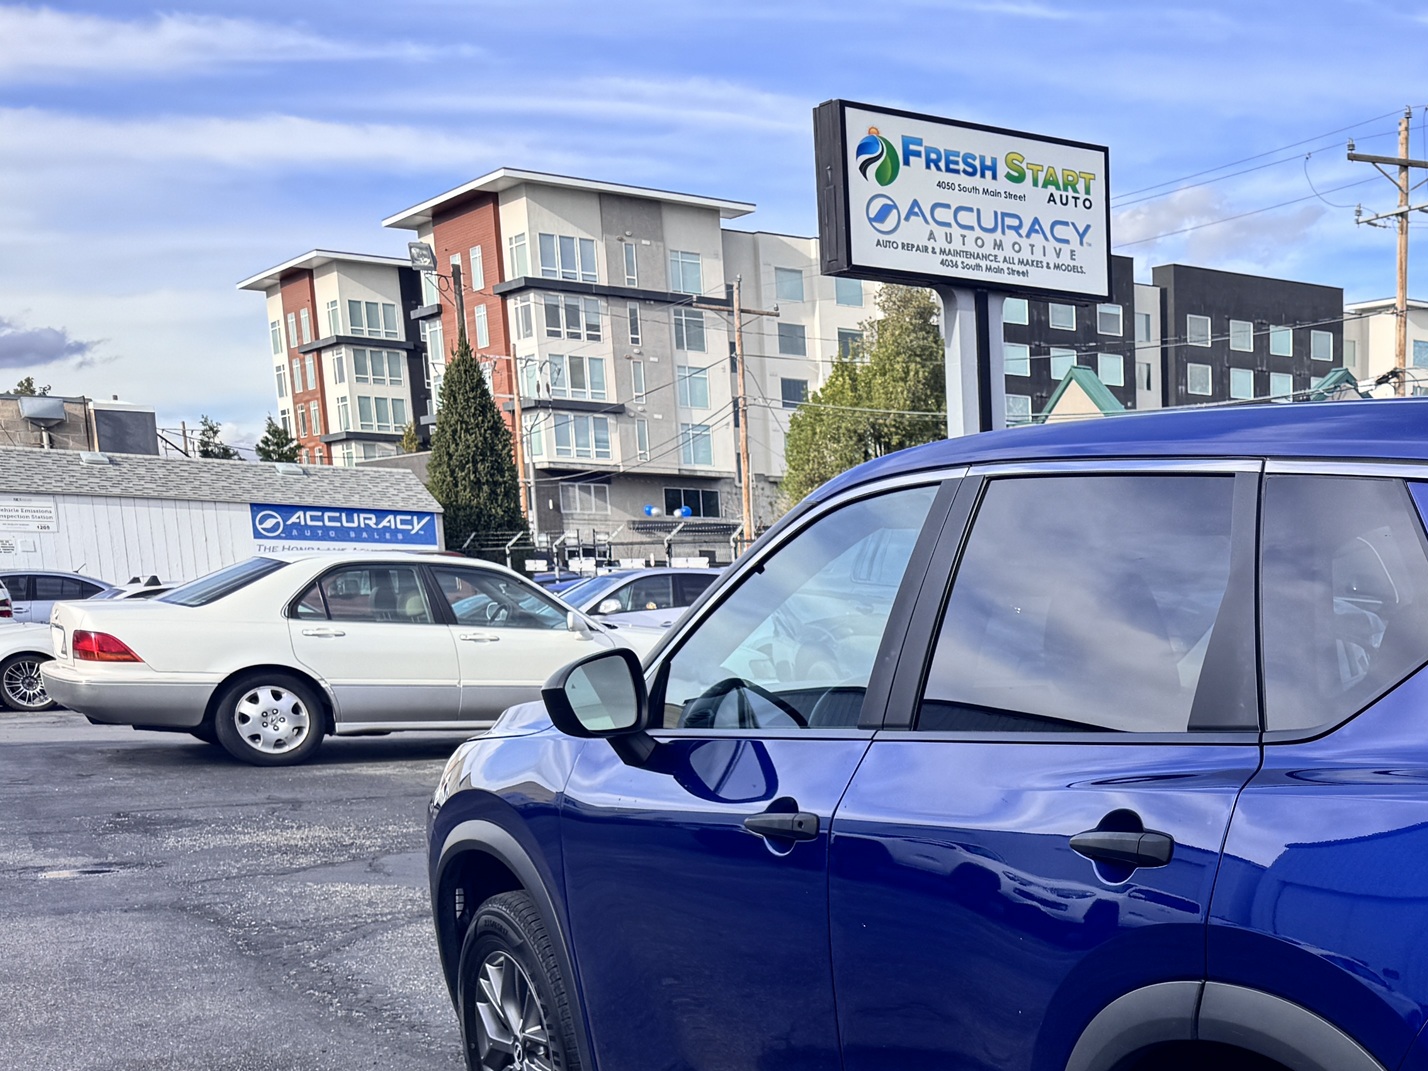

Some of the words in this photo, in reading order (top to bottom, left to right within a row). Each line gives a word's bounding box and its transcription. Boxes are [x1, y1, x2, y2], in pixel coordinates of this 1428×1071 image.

[901, 134, 998, 181] FRESH
[1004, 151, 1096, 196] START
[936, 180, 956, 191] 4050
[957, 181, 980, 195] South
[982, 187, 1002, 198] Main
[1004, 191, 1026, 202] Street
[1047, 192, 1093, 210] AUTO
[903, 198, 1092, 247] ACCURACY
[876, 238, 899, 250] AUTO
[901, 241, 930, 254] REPAIR
[931, 246, 937, 255] &
[1002, 255, 1016, 266] ALL
[1017, 257, 1044, 269] MAKES
[1045, 261, 1051, 269] &
[1053, 262, 1086, 275] MODELS.
[927, 230, 1077, 261] AUTOMOTIVE
[939, 259, 959, 270] 4036
[961, 260, 983, 273] South
[985, 264, 1005, 274] Main
[1007, 267, 1029, 278] Street
[286, 510, 431, 534] ACCURACY
[292, 529, 335, 537] AUTO
[350, 531, 403, 540] SALES
